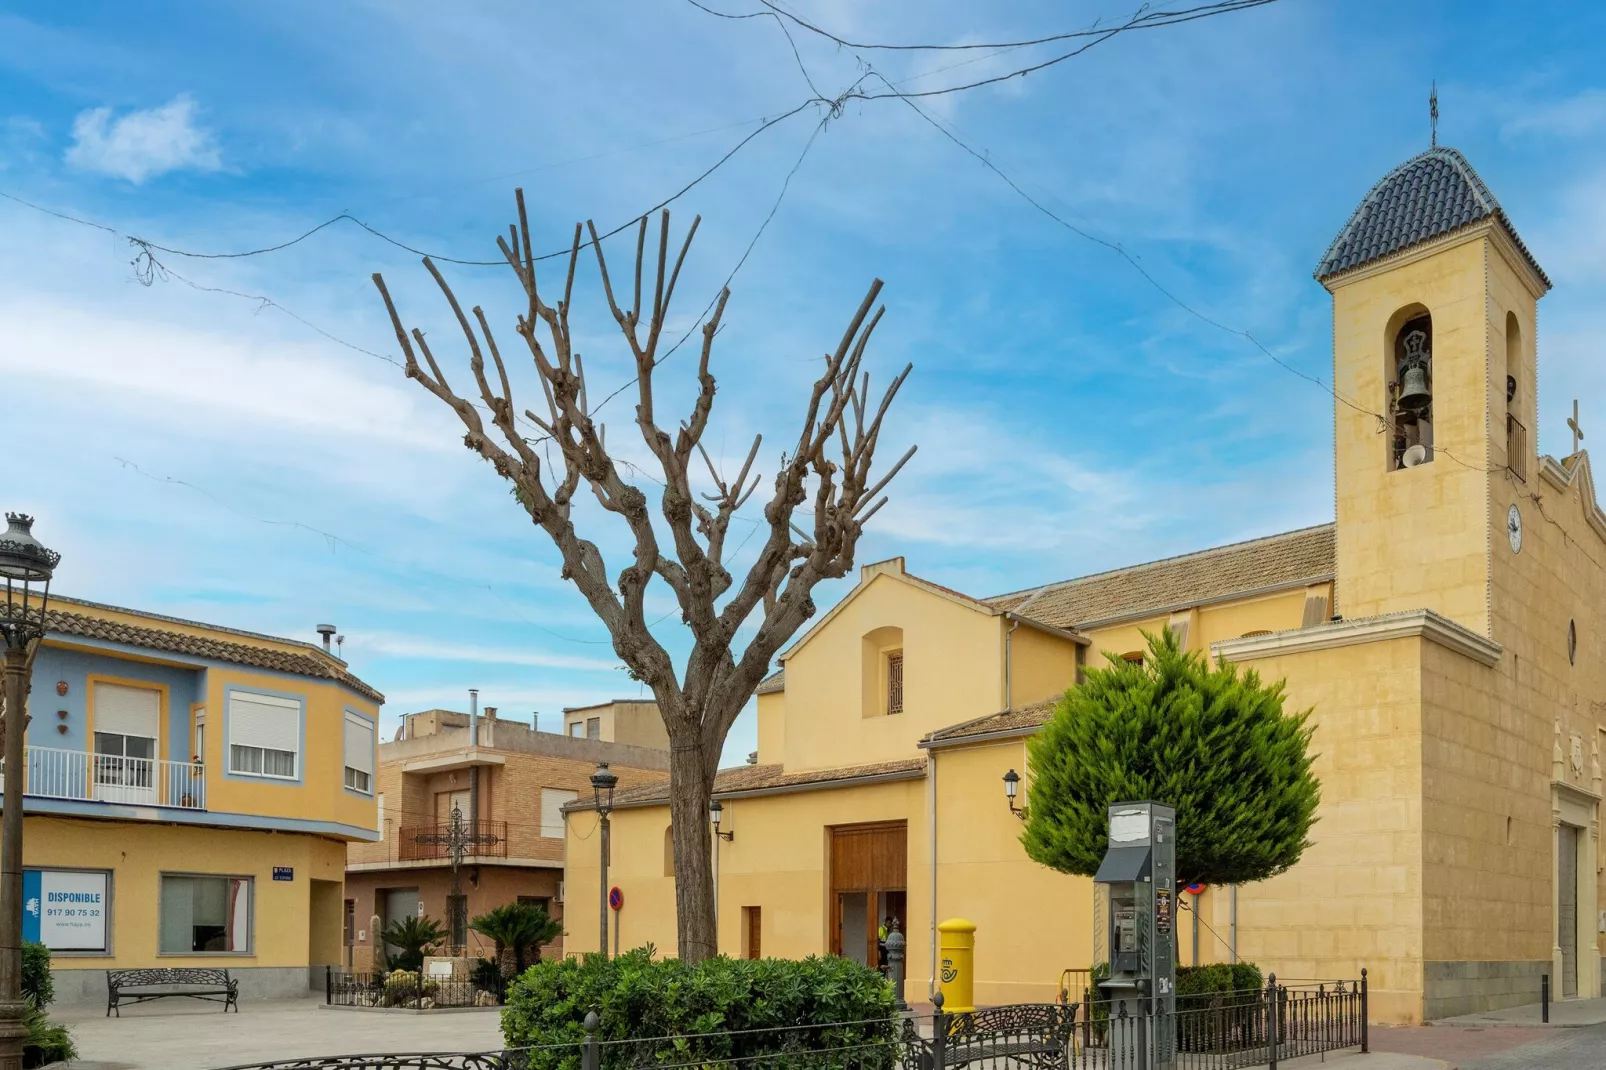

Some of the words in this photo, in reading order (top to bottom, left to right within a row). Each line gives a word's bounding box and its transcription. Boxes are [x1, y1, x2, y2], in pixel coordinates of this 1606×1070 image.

[48, 892, 101, 903] DISPONIBLE
[47, 908, 63, 916] 917
[77, 909, 88, 917] 75
[89, 909, 100, 917] 32
